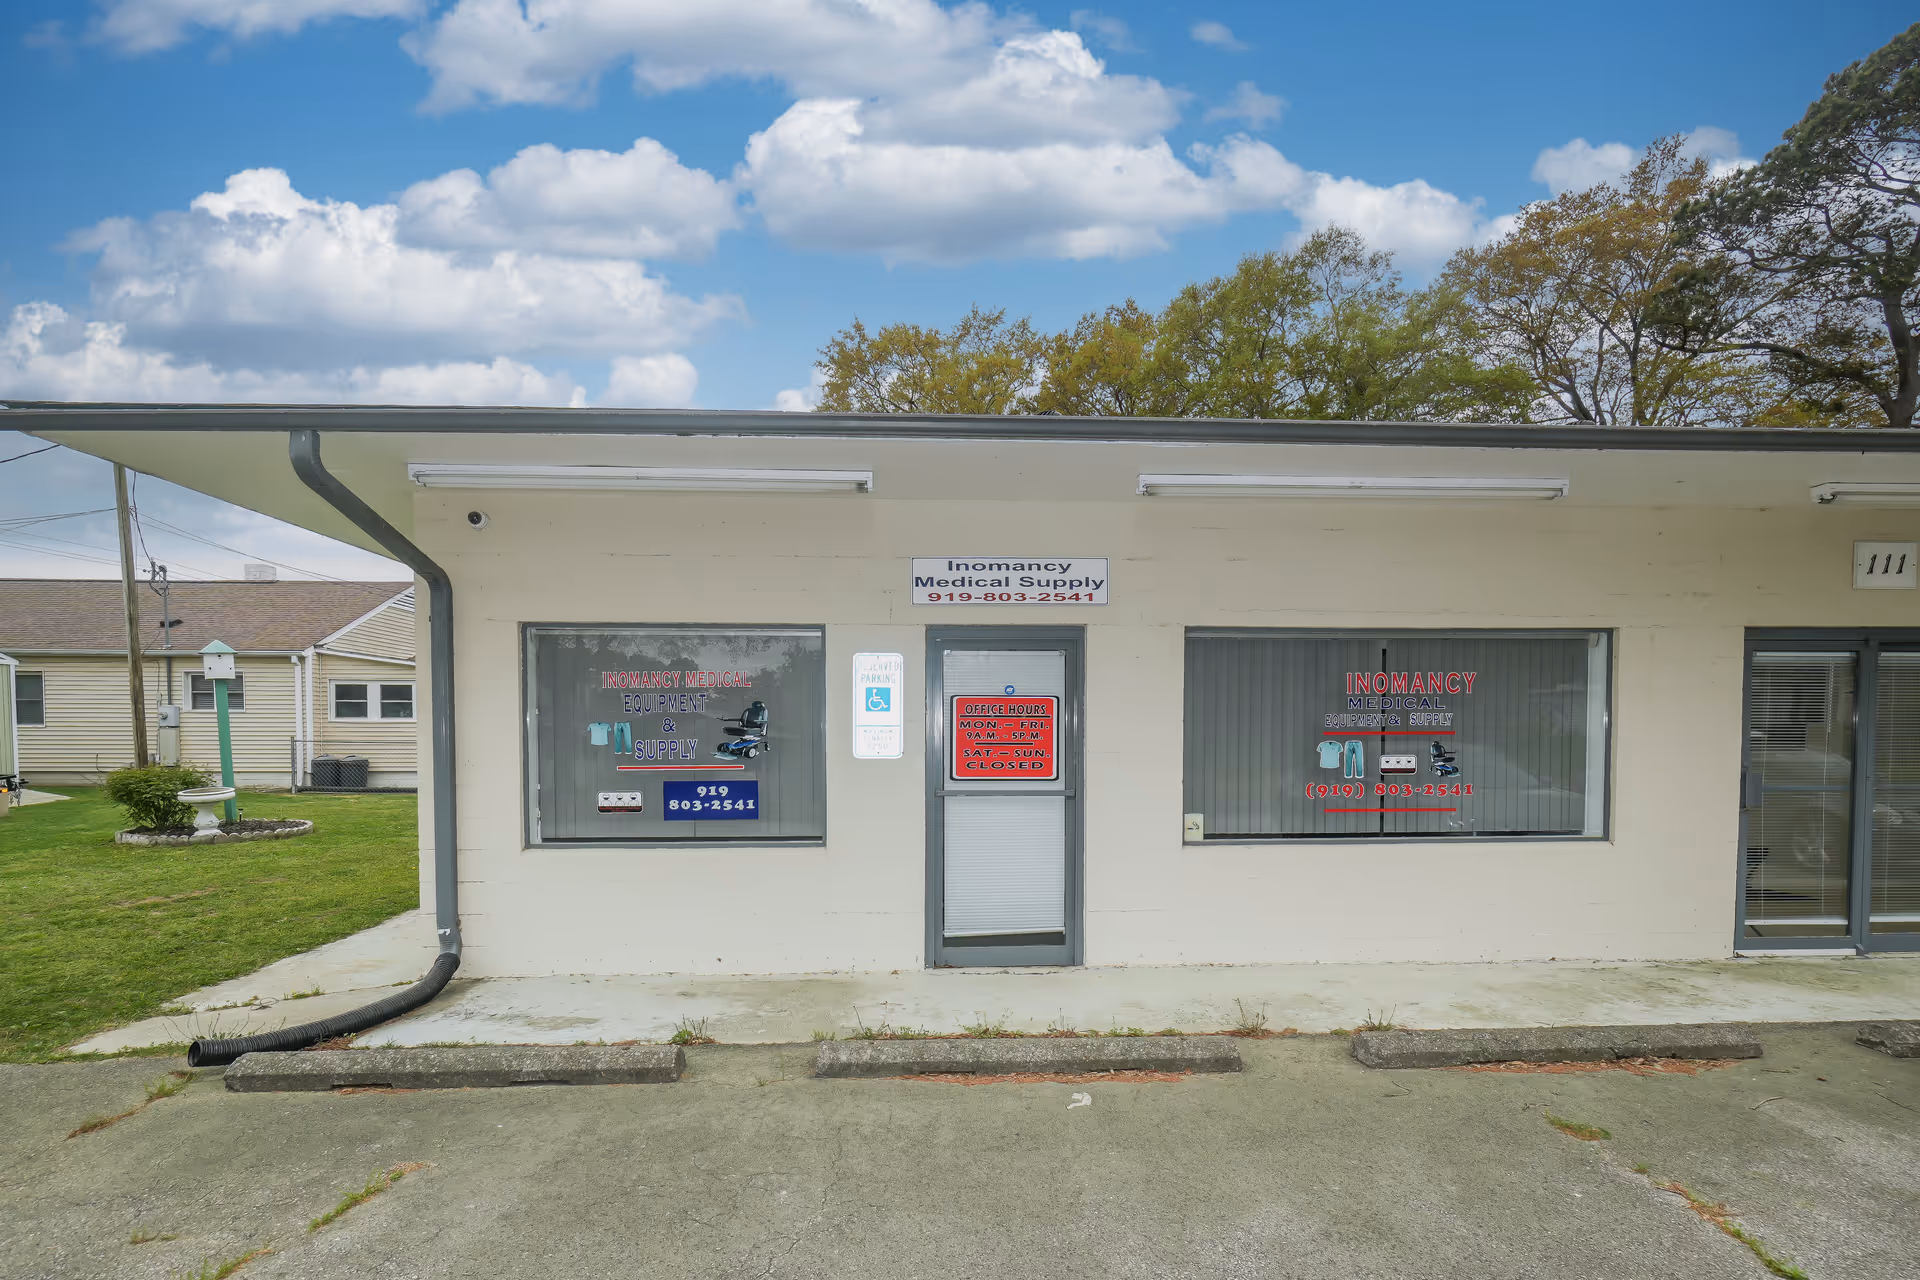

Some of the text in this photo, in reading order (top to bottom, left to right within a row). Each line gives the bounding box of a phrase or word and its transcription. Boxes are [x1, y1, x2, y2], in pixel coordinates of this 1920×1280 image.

[948, 560, 1072, 574] Inomancy
[1867, 553, 1906, 575] 111
[914, 576, 1105, 590] Medical Supply
[927, 592, 1094, 602] 919-803-2541
[602, 671, 752, 688] INOMANCY MEDICAL
[861, 673, 896, 684] PARKING
[1346, 672, 1477, 694] INOMANCY
[624, 693, 707, 715] EQUIPMENT
[965, 704, 1047, 715] OFFICE HOURS
[1348, 697, 1446, 710] MEDICAL
[662, 717, 676, 733] &
[1020, 721, 1050, 729] FRI.
[1325, 713, 1454, 728] EQUIPMENT & SUPPLY
[634, 739, 698, 760] SUPPLY
[1013, 749, 1051, 758] SUN.
[965, 761, 1044, 770] CLOSED
[696, 786, 729, 797] 919
[1305, 782, 1474, 799] (919) 803-2541
[668, 799, 756, 811] 803-2541
